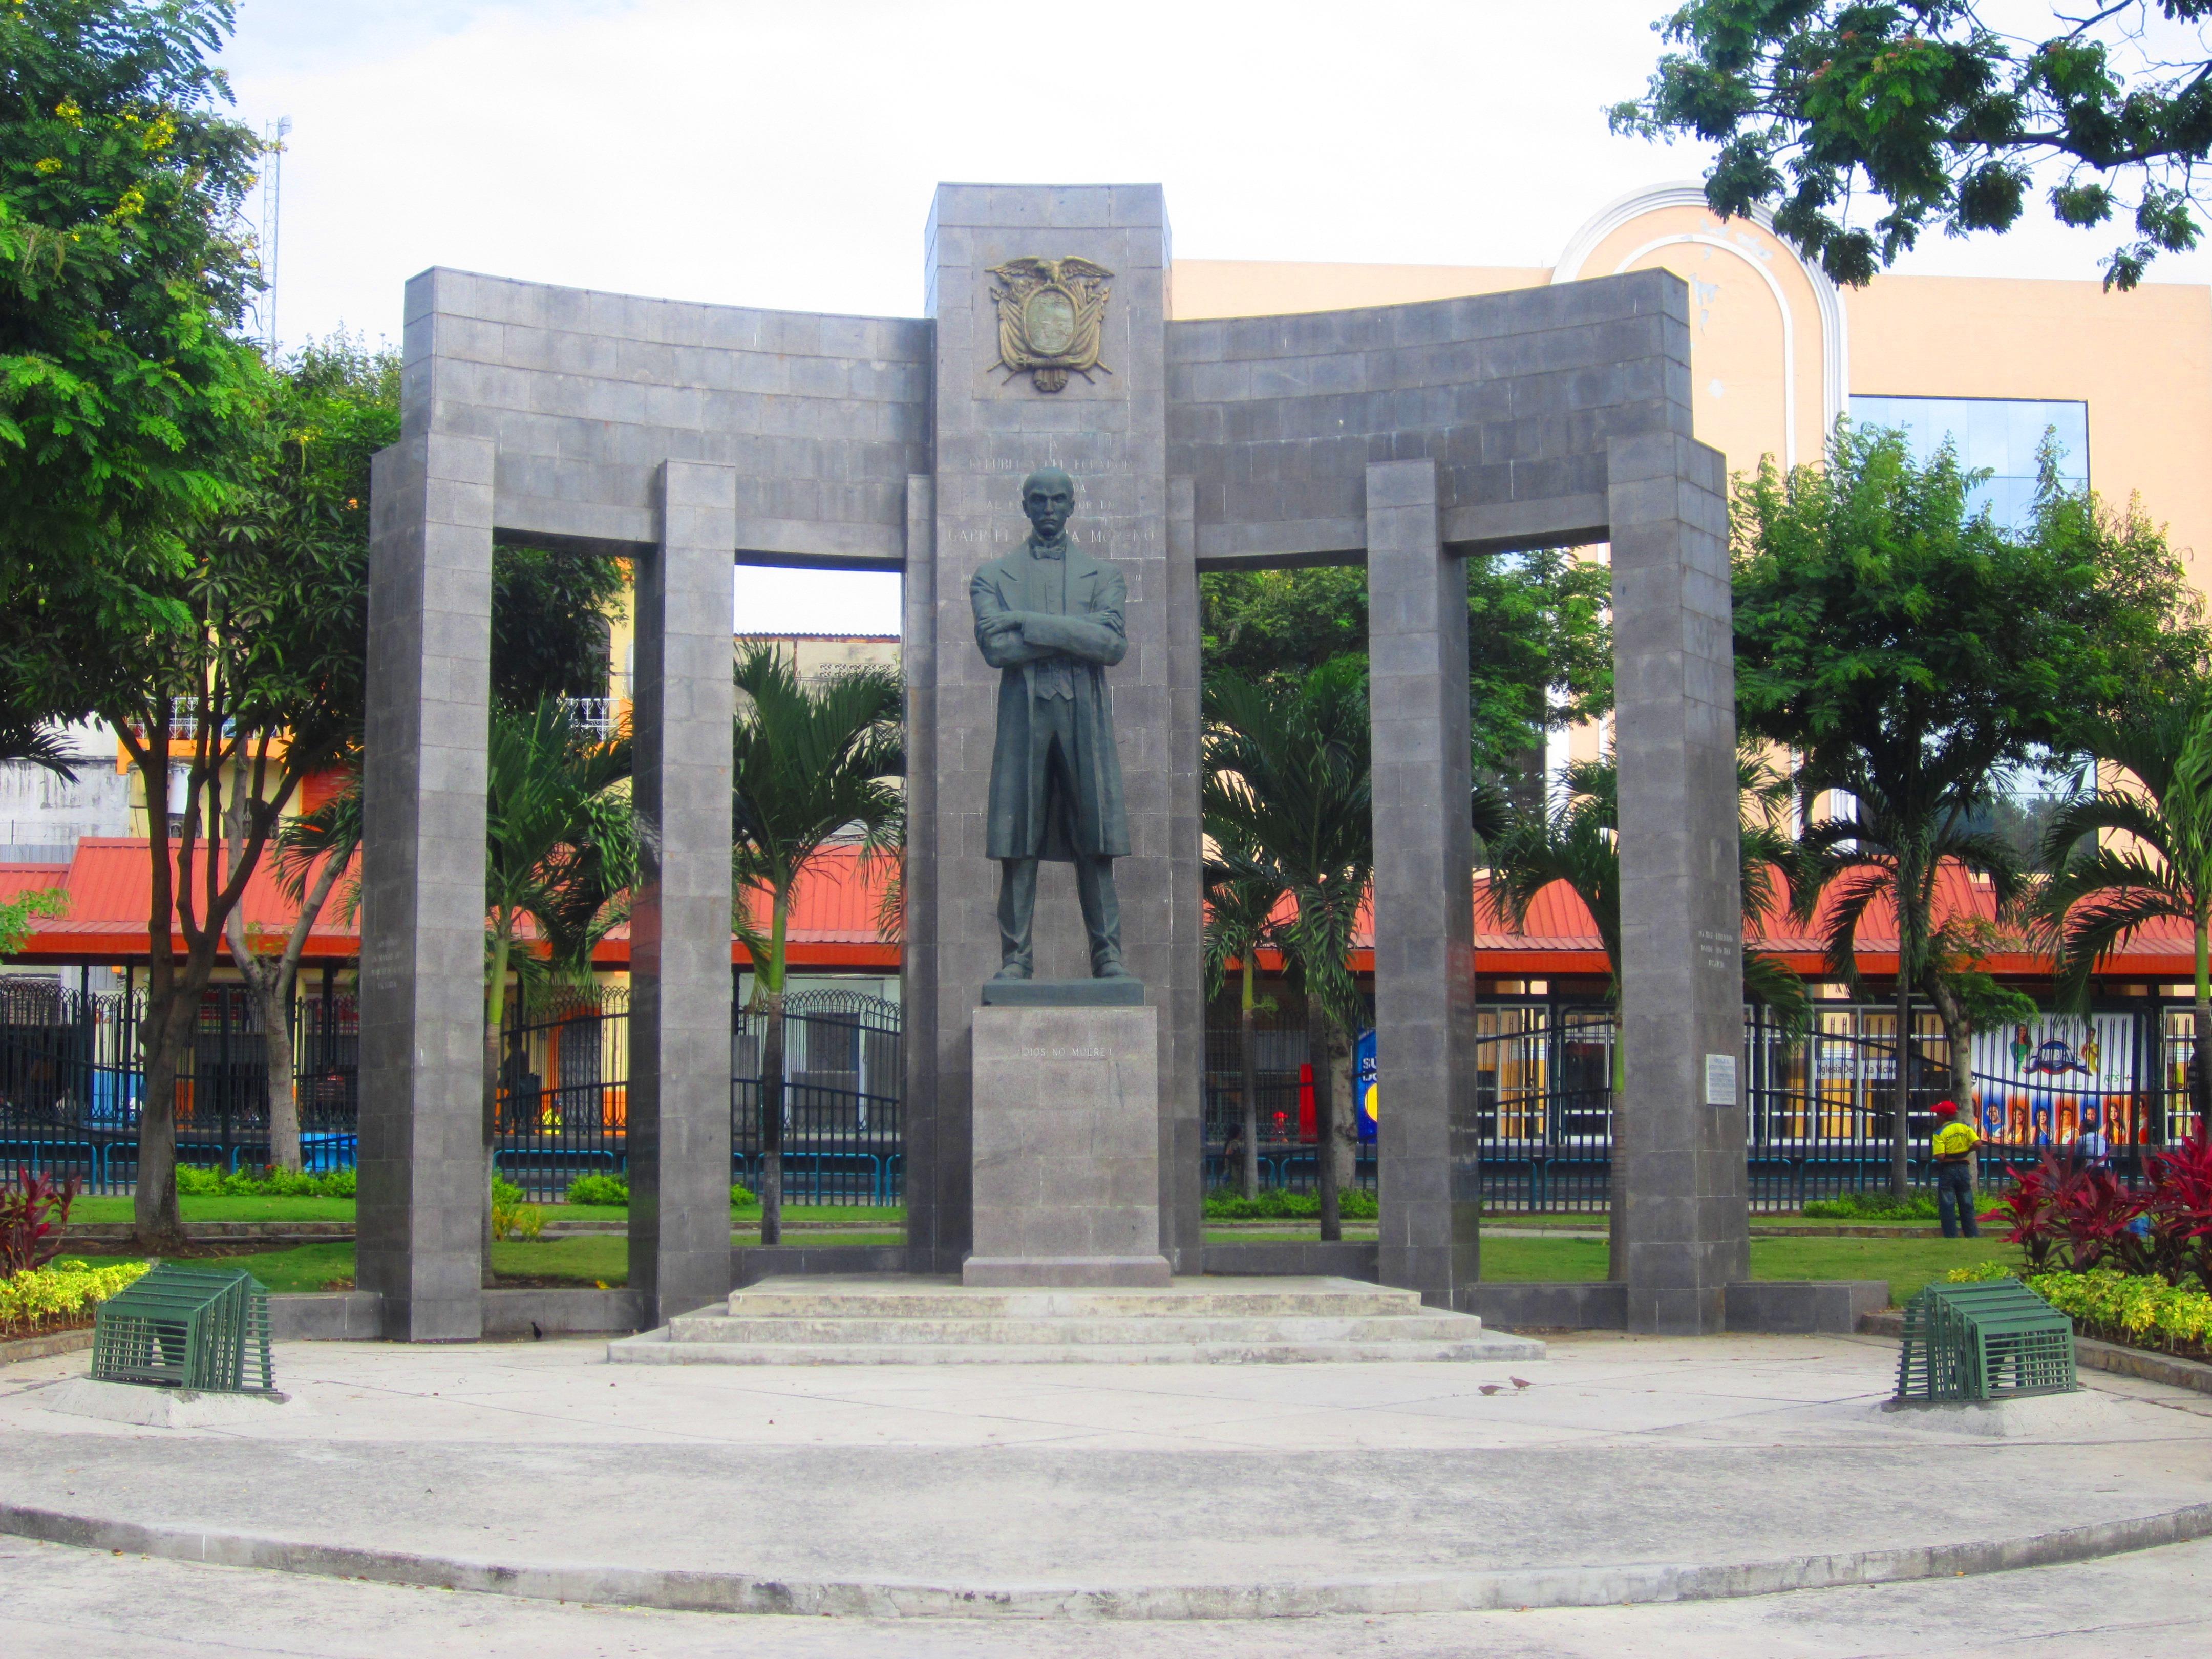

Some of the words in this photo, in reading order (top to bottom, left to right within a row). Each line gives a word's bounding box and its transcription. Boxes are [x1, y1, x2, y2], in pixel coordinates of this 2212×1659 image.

[969, 458, 1036, 470] REPUBLIA
[987, 500, 1001, 509] AL
[1091, 528, 1154, 543] MORENO
[1052, 1048, 1066, 1056] NO
